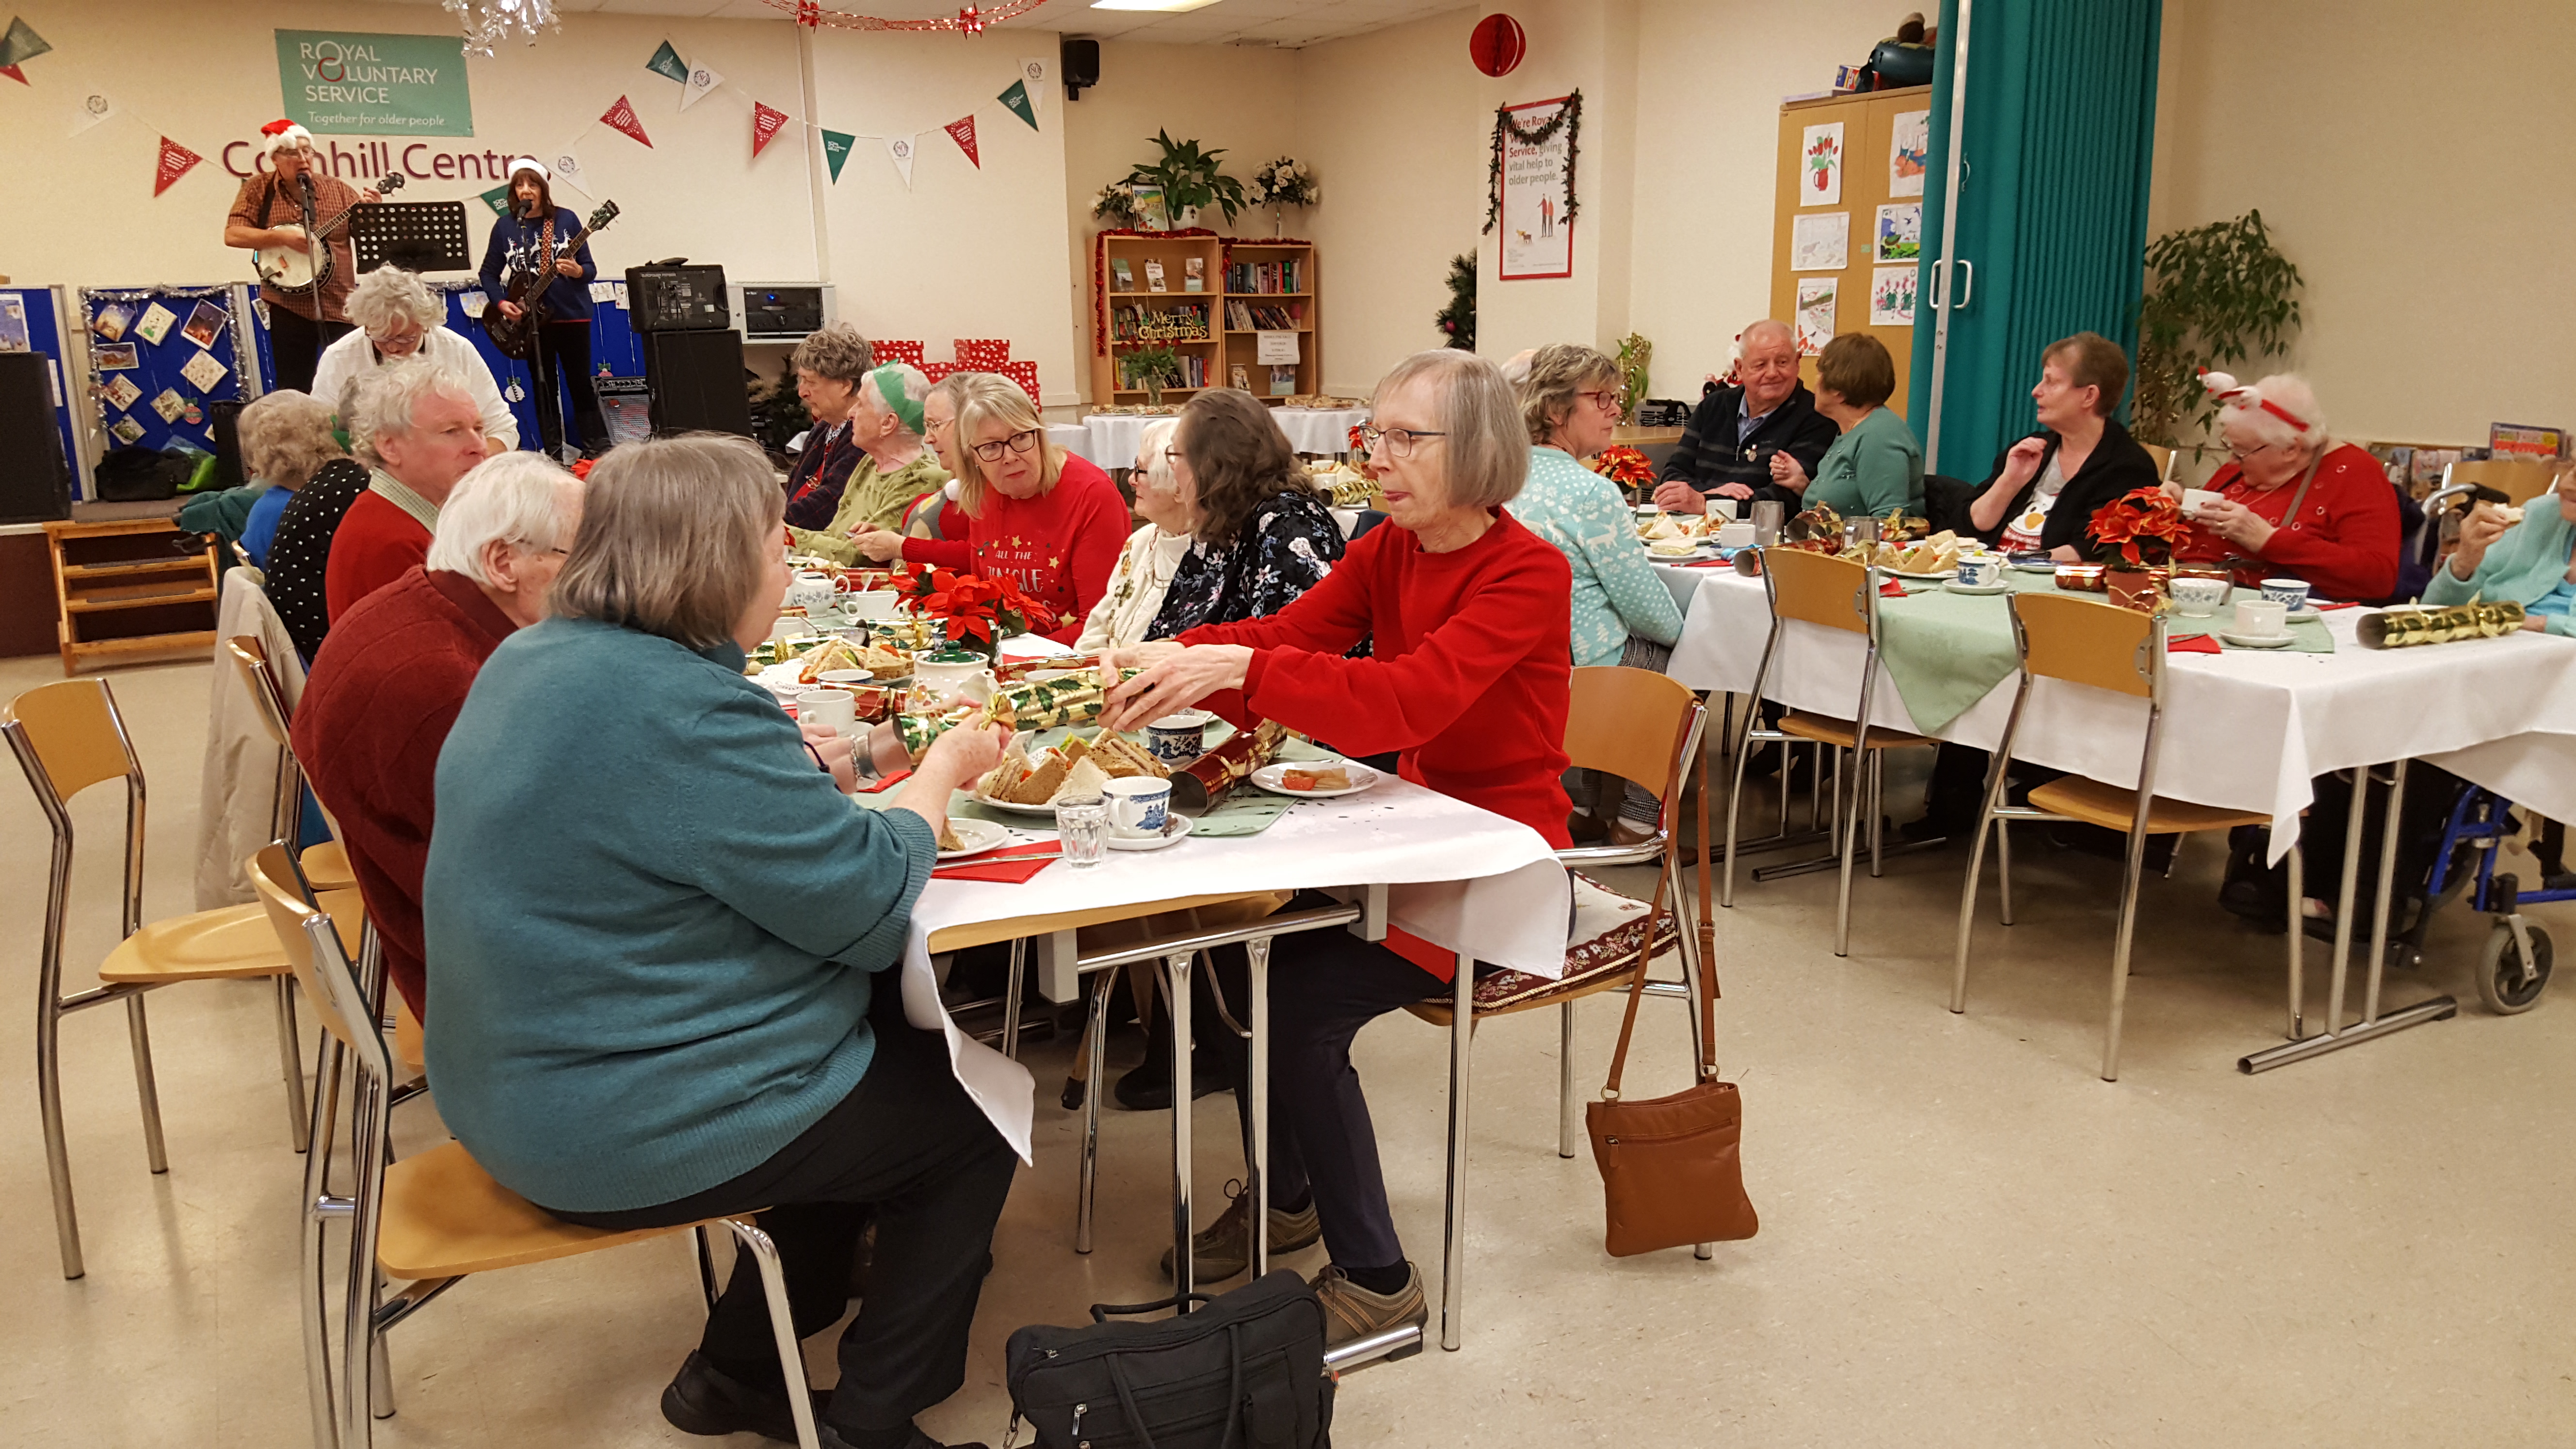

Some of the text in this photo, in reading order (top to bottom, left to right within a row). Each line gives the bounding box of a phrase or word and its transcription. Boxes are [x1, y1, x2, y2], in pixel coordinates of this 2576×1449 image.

[300, 41, 381, 65] ROYAL
[302, 57, 437, 84] VOLUNTARY
[306, 85, 390, 104] SERVICE
[308, 112, 445, 128] Together for older people
[1509, 143, 1562, 158] Service, giving
[223, 141, 388, 177] Cnhill
[403, 143, 537, 180] Centr
[1509, 158, 1553, 171] vital help to
[1509, 171, 1558, 186] older people.
[1151, 311, 1194, 325] Merry
[1139, 325, 1208, 339] Christmas
[995, 550, 1032, 560] ALL THE
